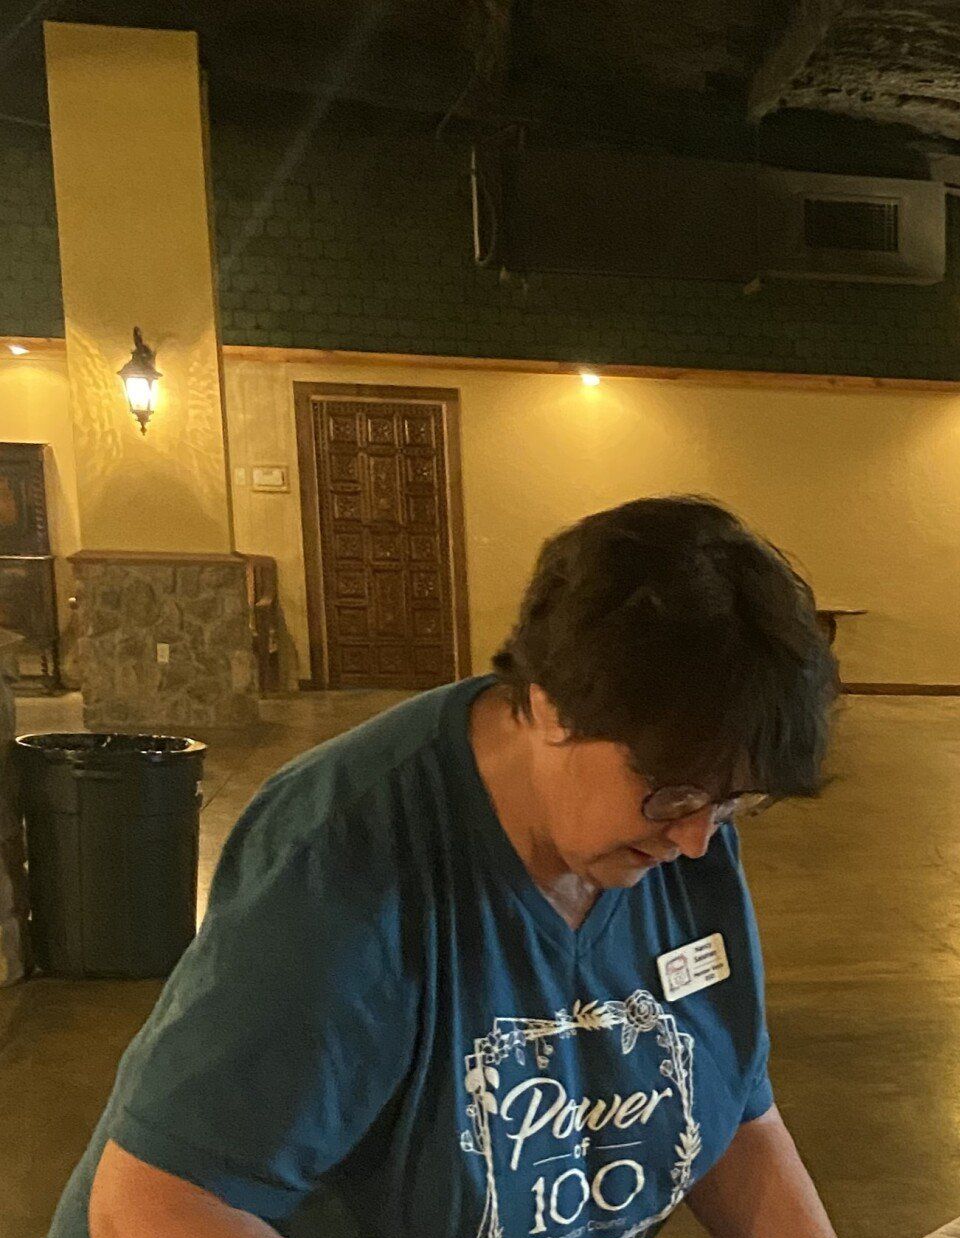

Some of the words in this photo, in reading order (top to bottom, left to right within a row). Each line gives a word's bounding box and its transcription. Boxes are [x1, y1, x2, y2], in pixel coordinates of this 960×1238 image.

[501, 1077, 673, 1171] Power
[573, 1137, 591, 1159] of
[528, 1159, 645, 1234] 100
